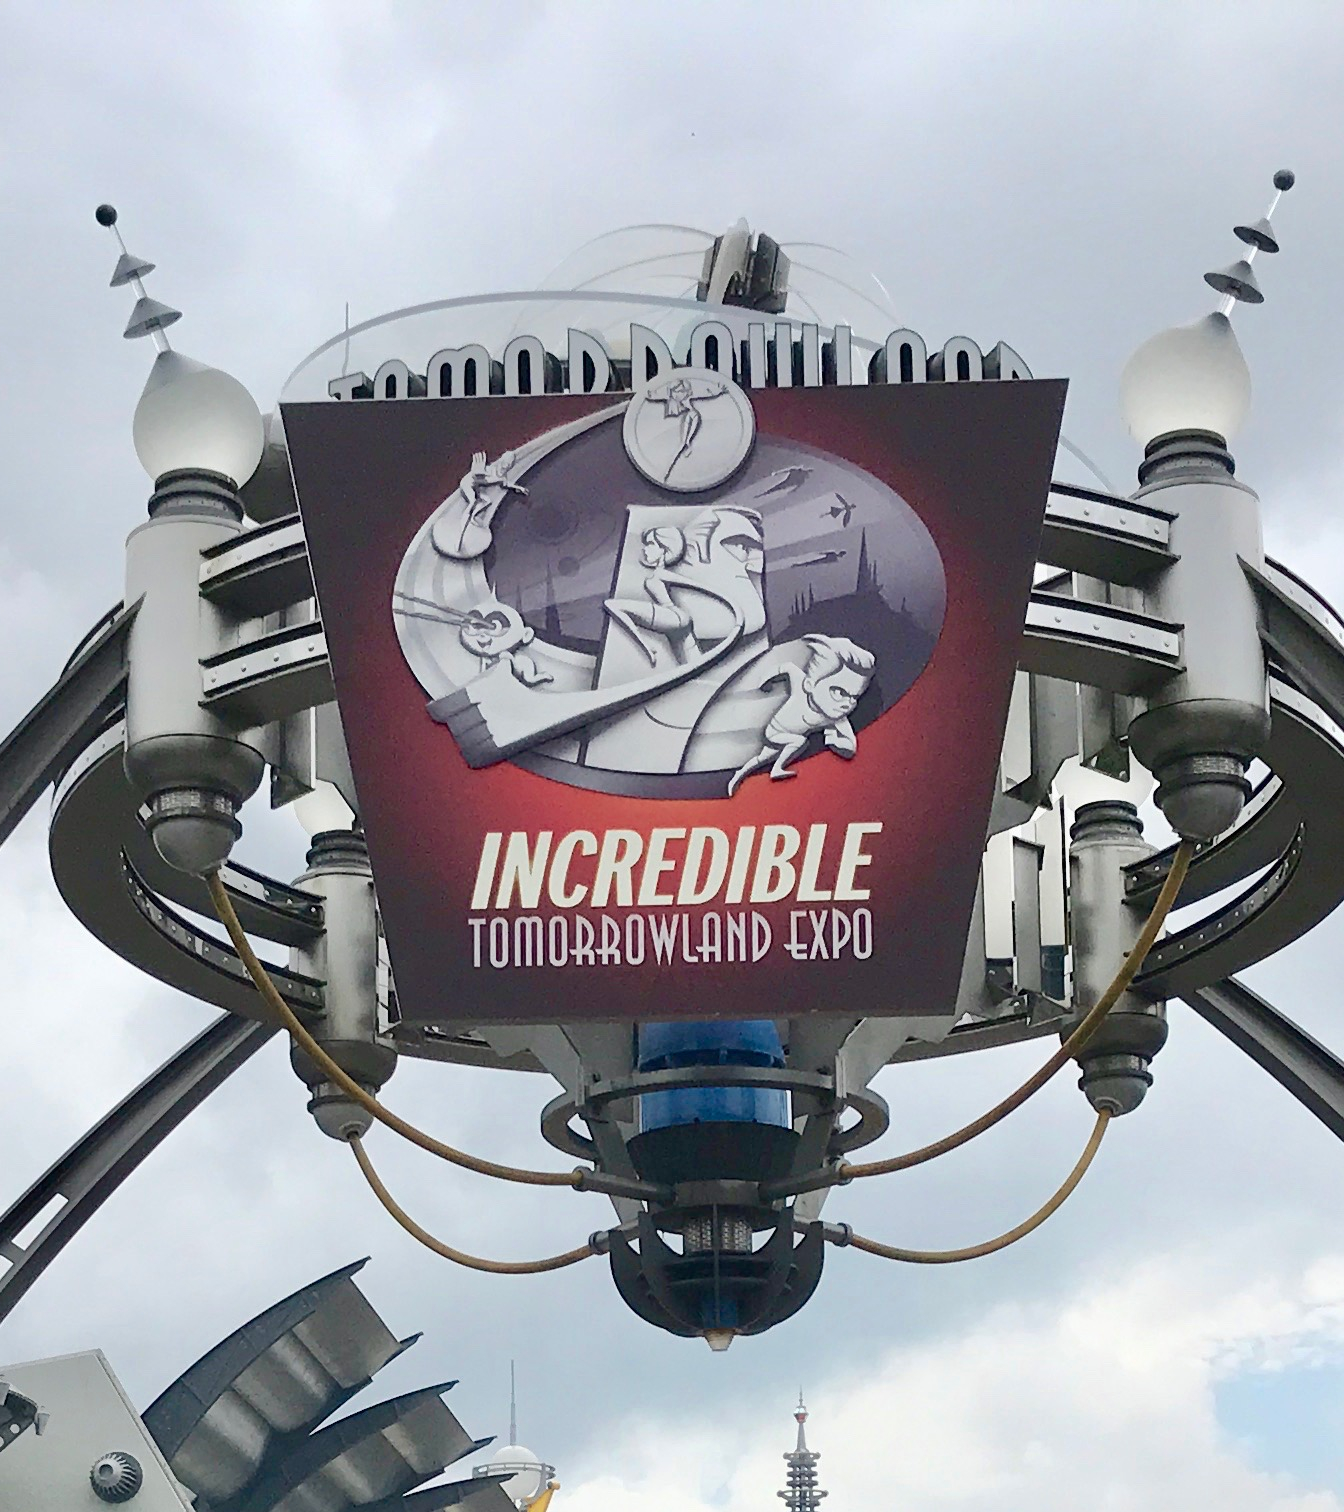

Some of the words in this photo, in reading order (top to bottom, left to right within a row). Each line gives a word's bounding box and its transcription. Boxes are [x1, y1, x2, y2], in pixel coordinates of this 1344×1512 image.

[470, 822, 883, 910] INCREDIBLE
[468, 909, 772, 969] TOMORROWLAND
[783, 907, 874, 961] EXPO
